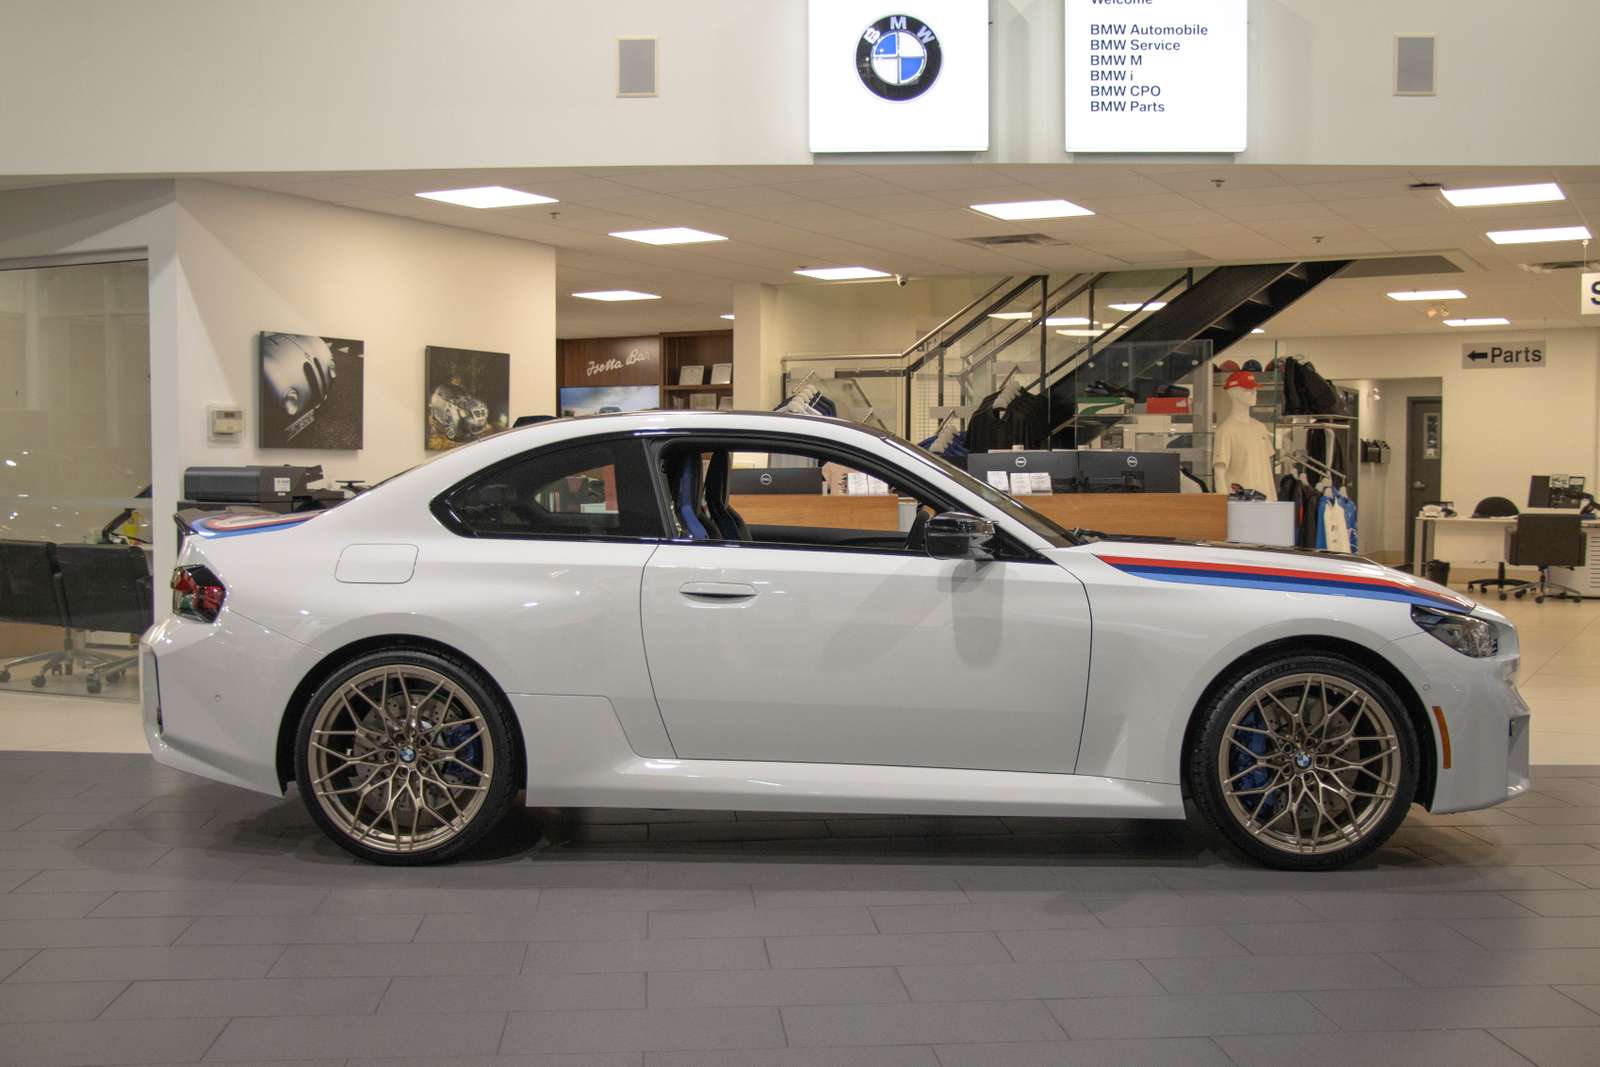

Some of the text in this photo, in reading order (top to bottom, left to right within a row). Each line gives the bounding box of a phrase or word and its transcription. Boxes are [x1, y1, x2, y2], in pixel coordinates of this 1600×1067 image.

[864, 16, 936, 45] BMW
[1090, 24, 1208, 35] BMW Automobile
[1090, 39, 1181, 50] BMW Service
[1090, 54, 1143, 65] BMW M
[1090, 70, 1134, 81] BMW i
[1090, 85, 1161, 96] BMW CPO
[1090, 100, 1165, 112] BMW Parts
[1490, 347, 1542, 363] Parts
